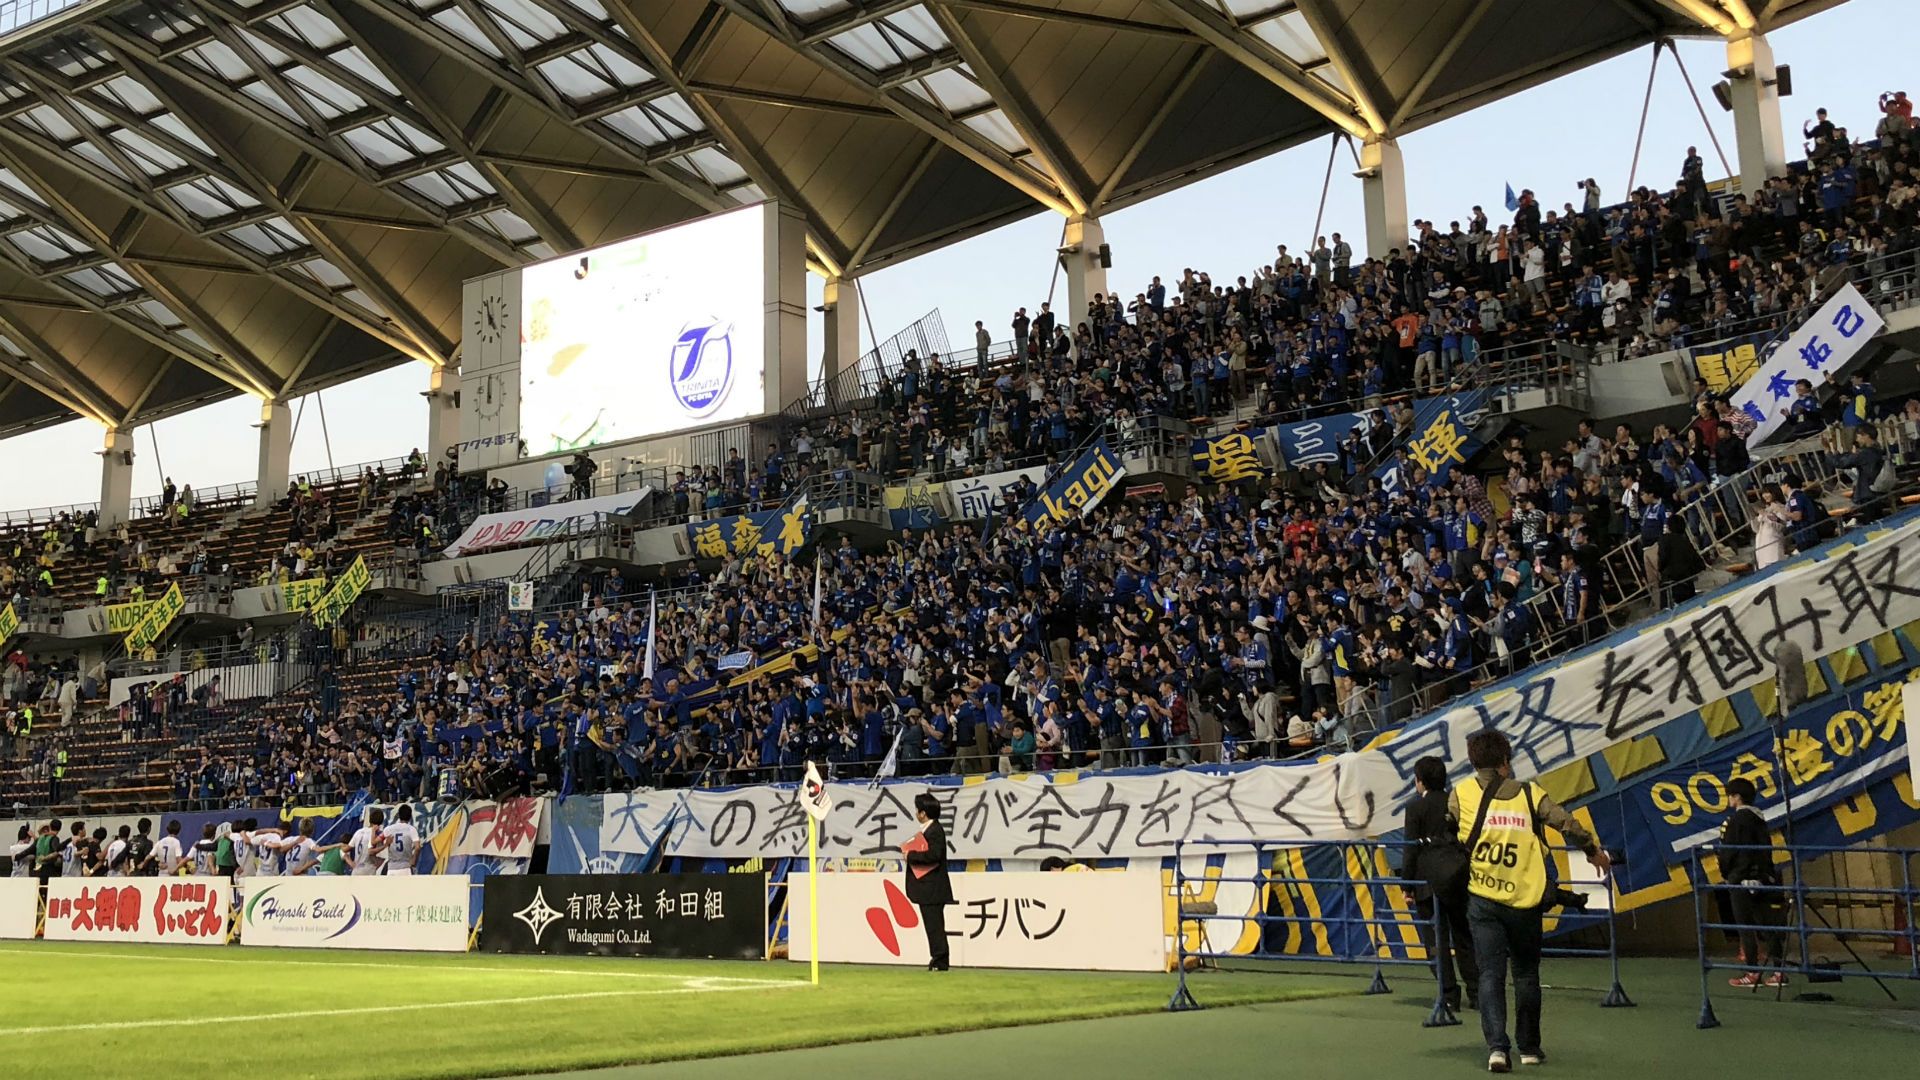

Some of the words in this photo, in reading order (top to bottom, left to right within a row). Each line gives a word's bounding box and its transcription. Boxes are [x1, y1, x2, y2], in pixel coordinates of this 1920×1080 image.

[1487, 815, 1526, 828] anon
[394, 832, 404, 853] 5
[162, 845, 169, 864] 7
[153, 884, 223, 937] くいどん
[261, 897, 307, 923] Higashi
[312, 898, 348, 920] Build
[363, 907, 401, 923] 株式会社
[404, 904, 463, 924] 千葉東建設
[566, 890, 644, 921] 有限会社
[655, 887, 725, 923] 和田組
[567, 928, 615, 946] Wadagumi
